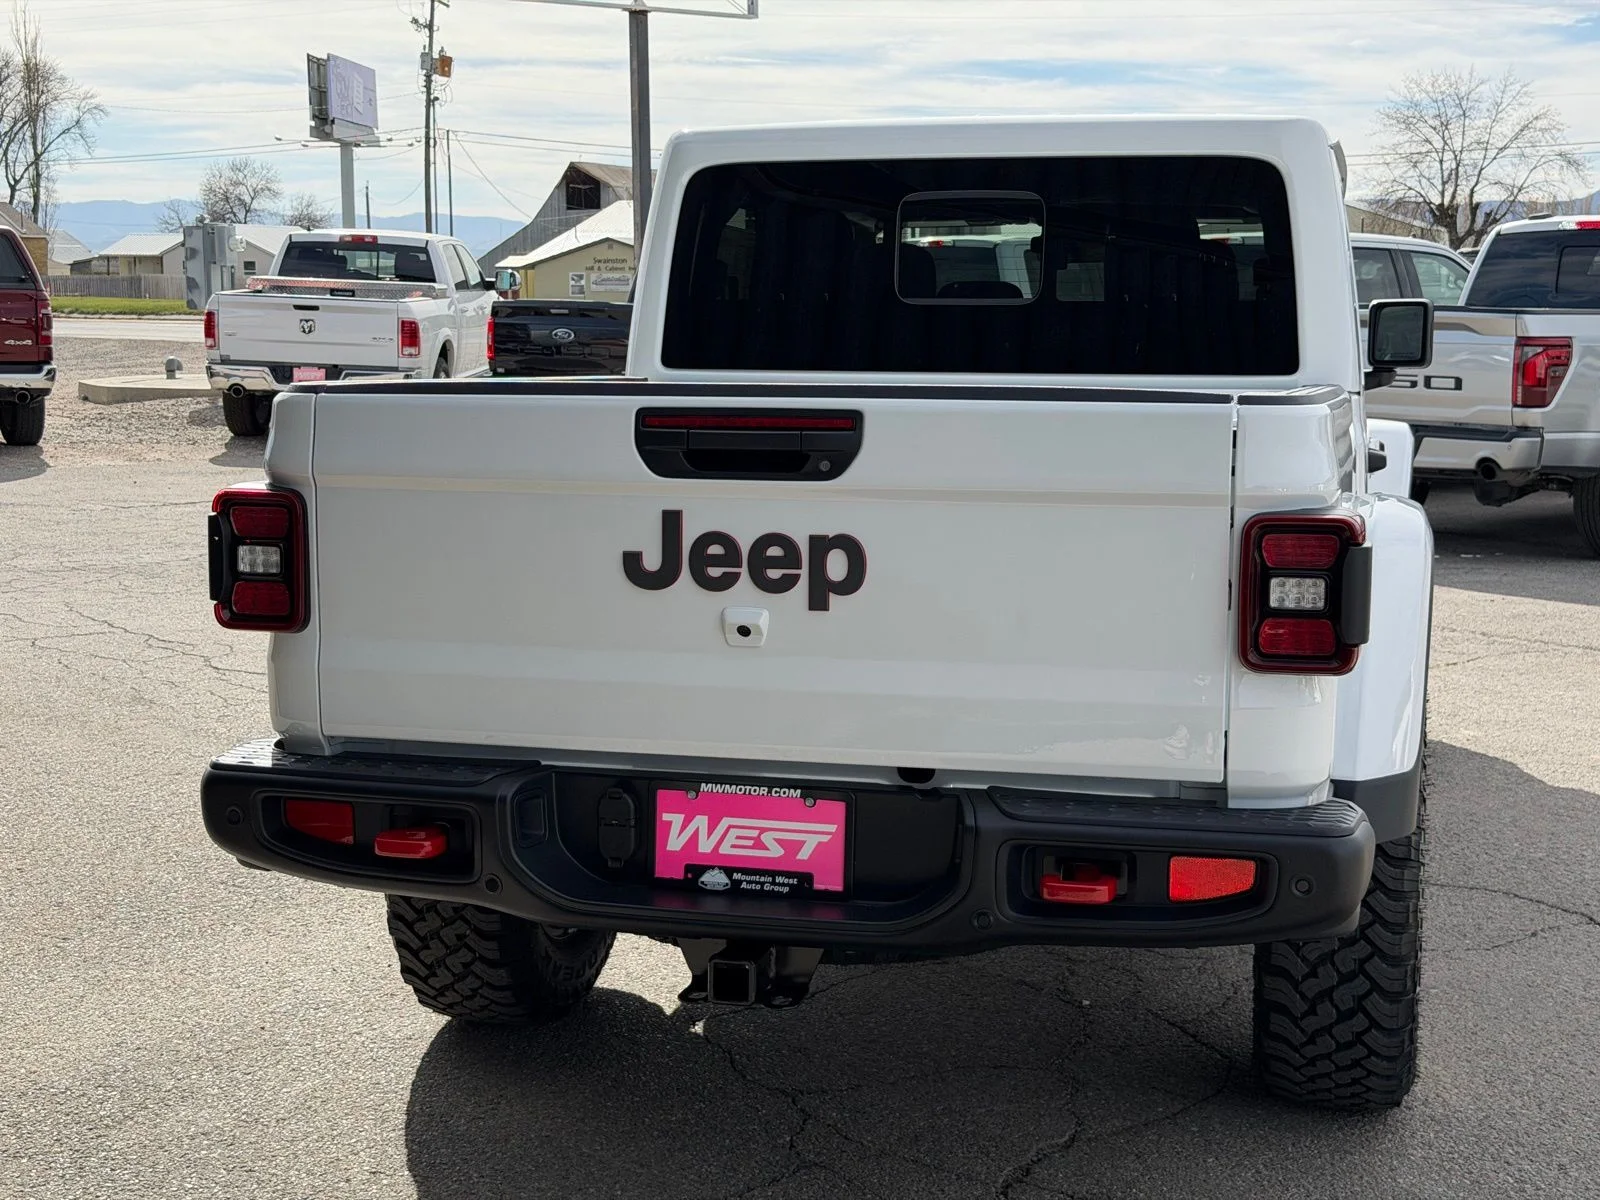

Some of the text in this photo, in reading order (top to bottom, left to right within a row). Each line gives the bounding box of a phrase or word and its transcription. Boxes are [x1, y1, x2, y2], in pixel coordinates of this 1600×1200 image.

[593, 256, 627, 264] Swainston
[622, 508, 868, 612] Jeep
[700, 782, 802, 799] MWMOTOR.COM
[661, 812, 838, 860] WEST
[732, 872, 798, 885] Mountain West
[740, 881, 790, 894] Auto Group
